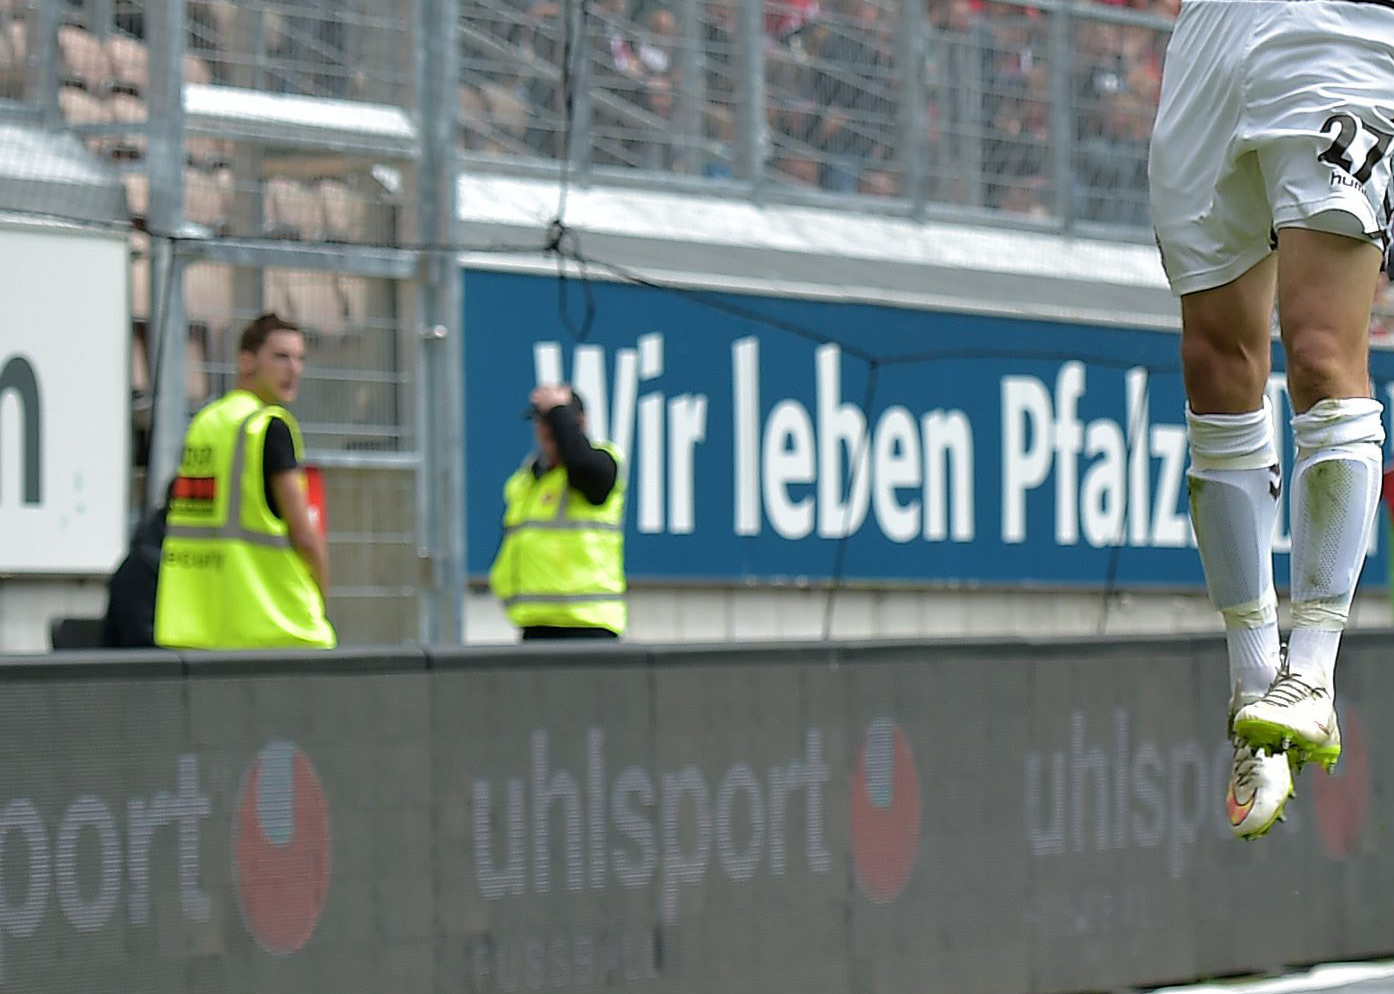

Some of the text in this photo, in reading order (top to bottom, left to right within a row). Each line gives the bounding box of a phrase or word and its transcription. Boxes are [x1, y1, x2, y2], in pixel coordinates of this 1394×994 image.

[1317, 114, 1394, 185] 27
[533, 331, 707, 535] Wir
[731, 335, 976, 543] leben
[472, 726, 831, 927] uhlsport
